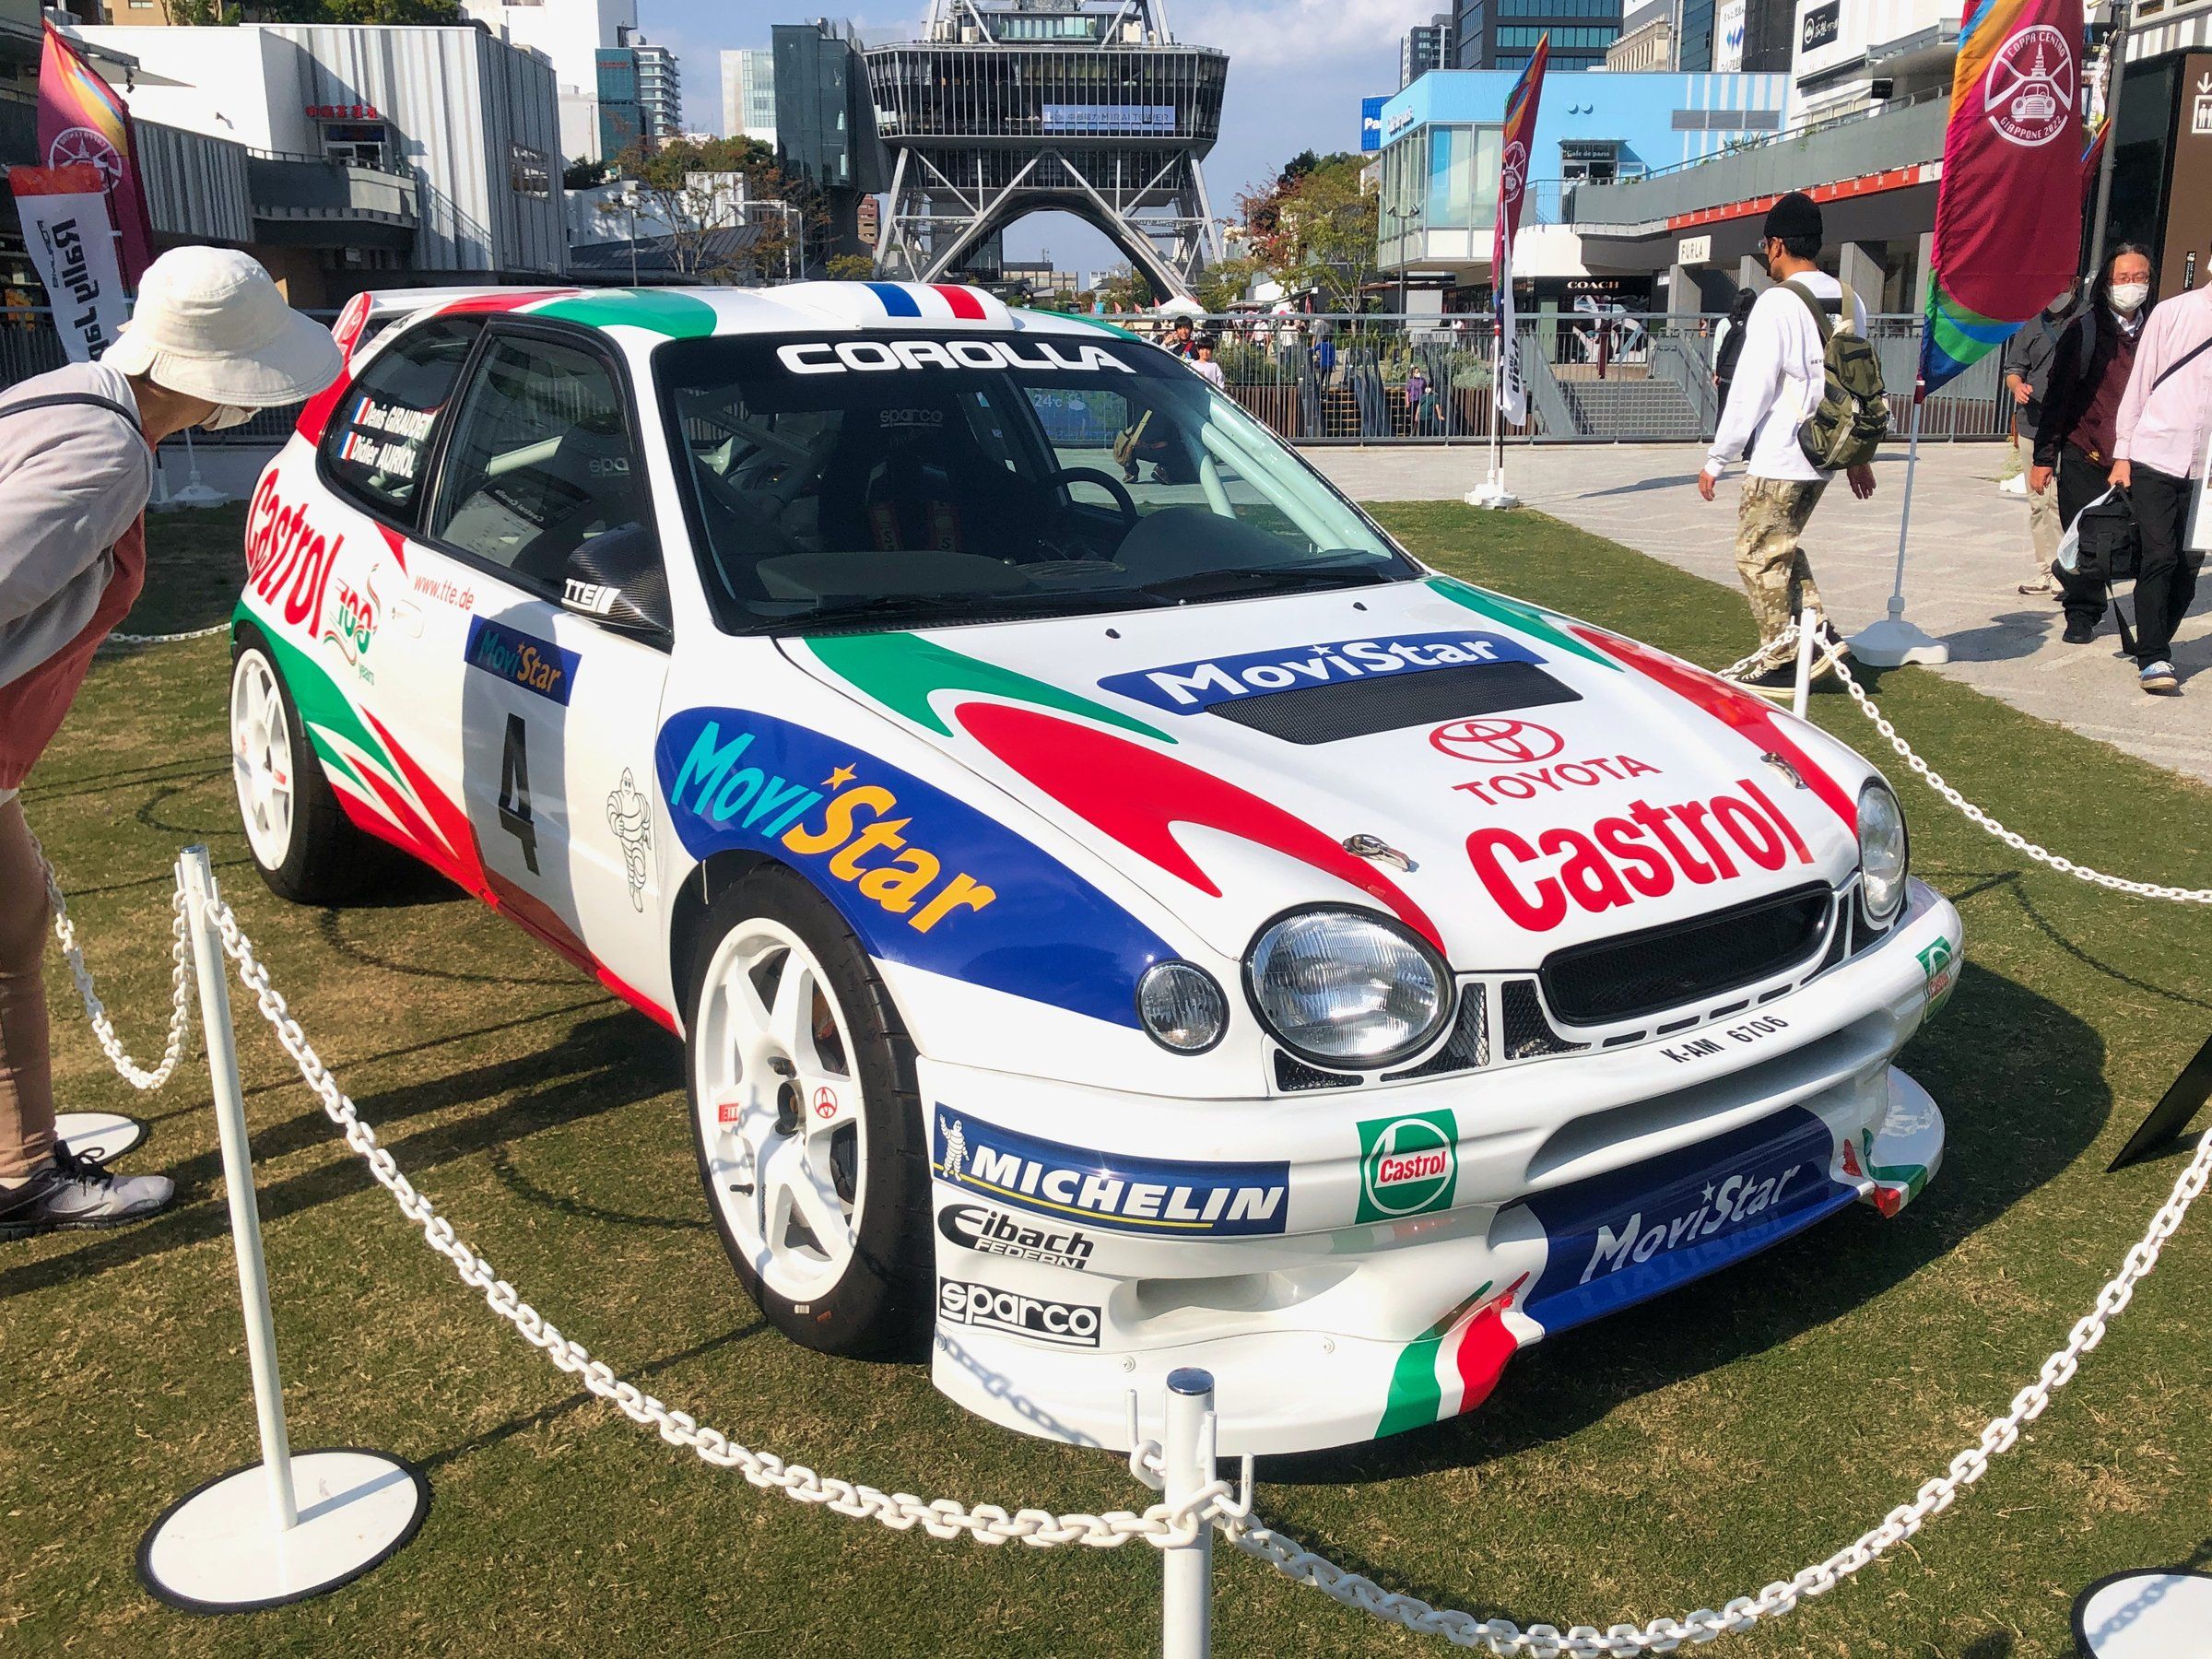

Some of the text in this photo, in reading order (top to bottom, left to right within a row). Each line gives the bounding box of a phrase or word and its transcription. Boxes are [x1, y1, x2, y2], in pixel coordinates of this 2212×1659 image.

[2007, 31, 2065, 57] COPPA CENTRO
[2000, 115, 2062, 139] GIAPPONE 2022
[1681, 241, 1703, 261] FURLA
[1567, 280, 1619, 289] COACH
[776, 340, 1137, 374] COROLLA
[879, 408, 945, 427] sparco
[375, 442, 417, 479] AURIOL
[244, 467, 345, 640] Castrol
[414, 574, 475, 611] www.tte.de
[562, 577, 601, 609] TTE
[1145, 637, 1494, 705] MoviStar
[499, 712, 541, 877] 4
[1452, 755, 1664, 806] TOYOTA
[1465, 778, 1816, 932] Castrol
[1659, 1016, 1790, 1063] K-AM 6706
[970, 1144, 1286, 1221] MICHELIN
[1380, 1151, 1447, 1183] Castrol
[937, 1203, 1095, 1259] Eibach
[1579, 1164, 1801, 1286] MoviStar
[973, 1238, 1081, 1270] FEDERN
[940, 1280, 1098, 1336] sparco
